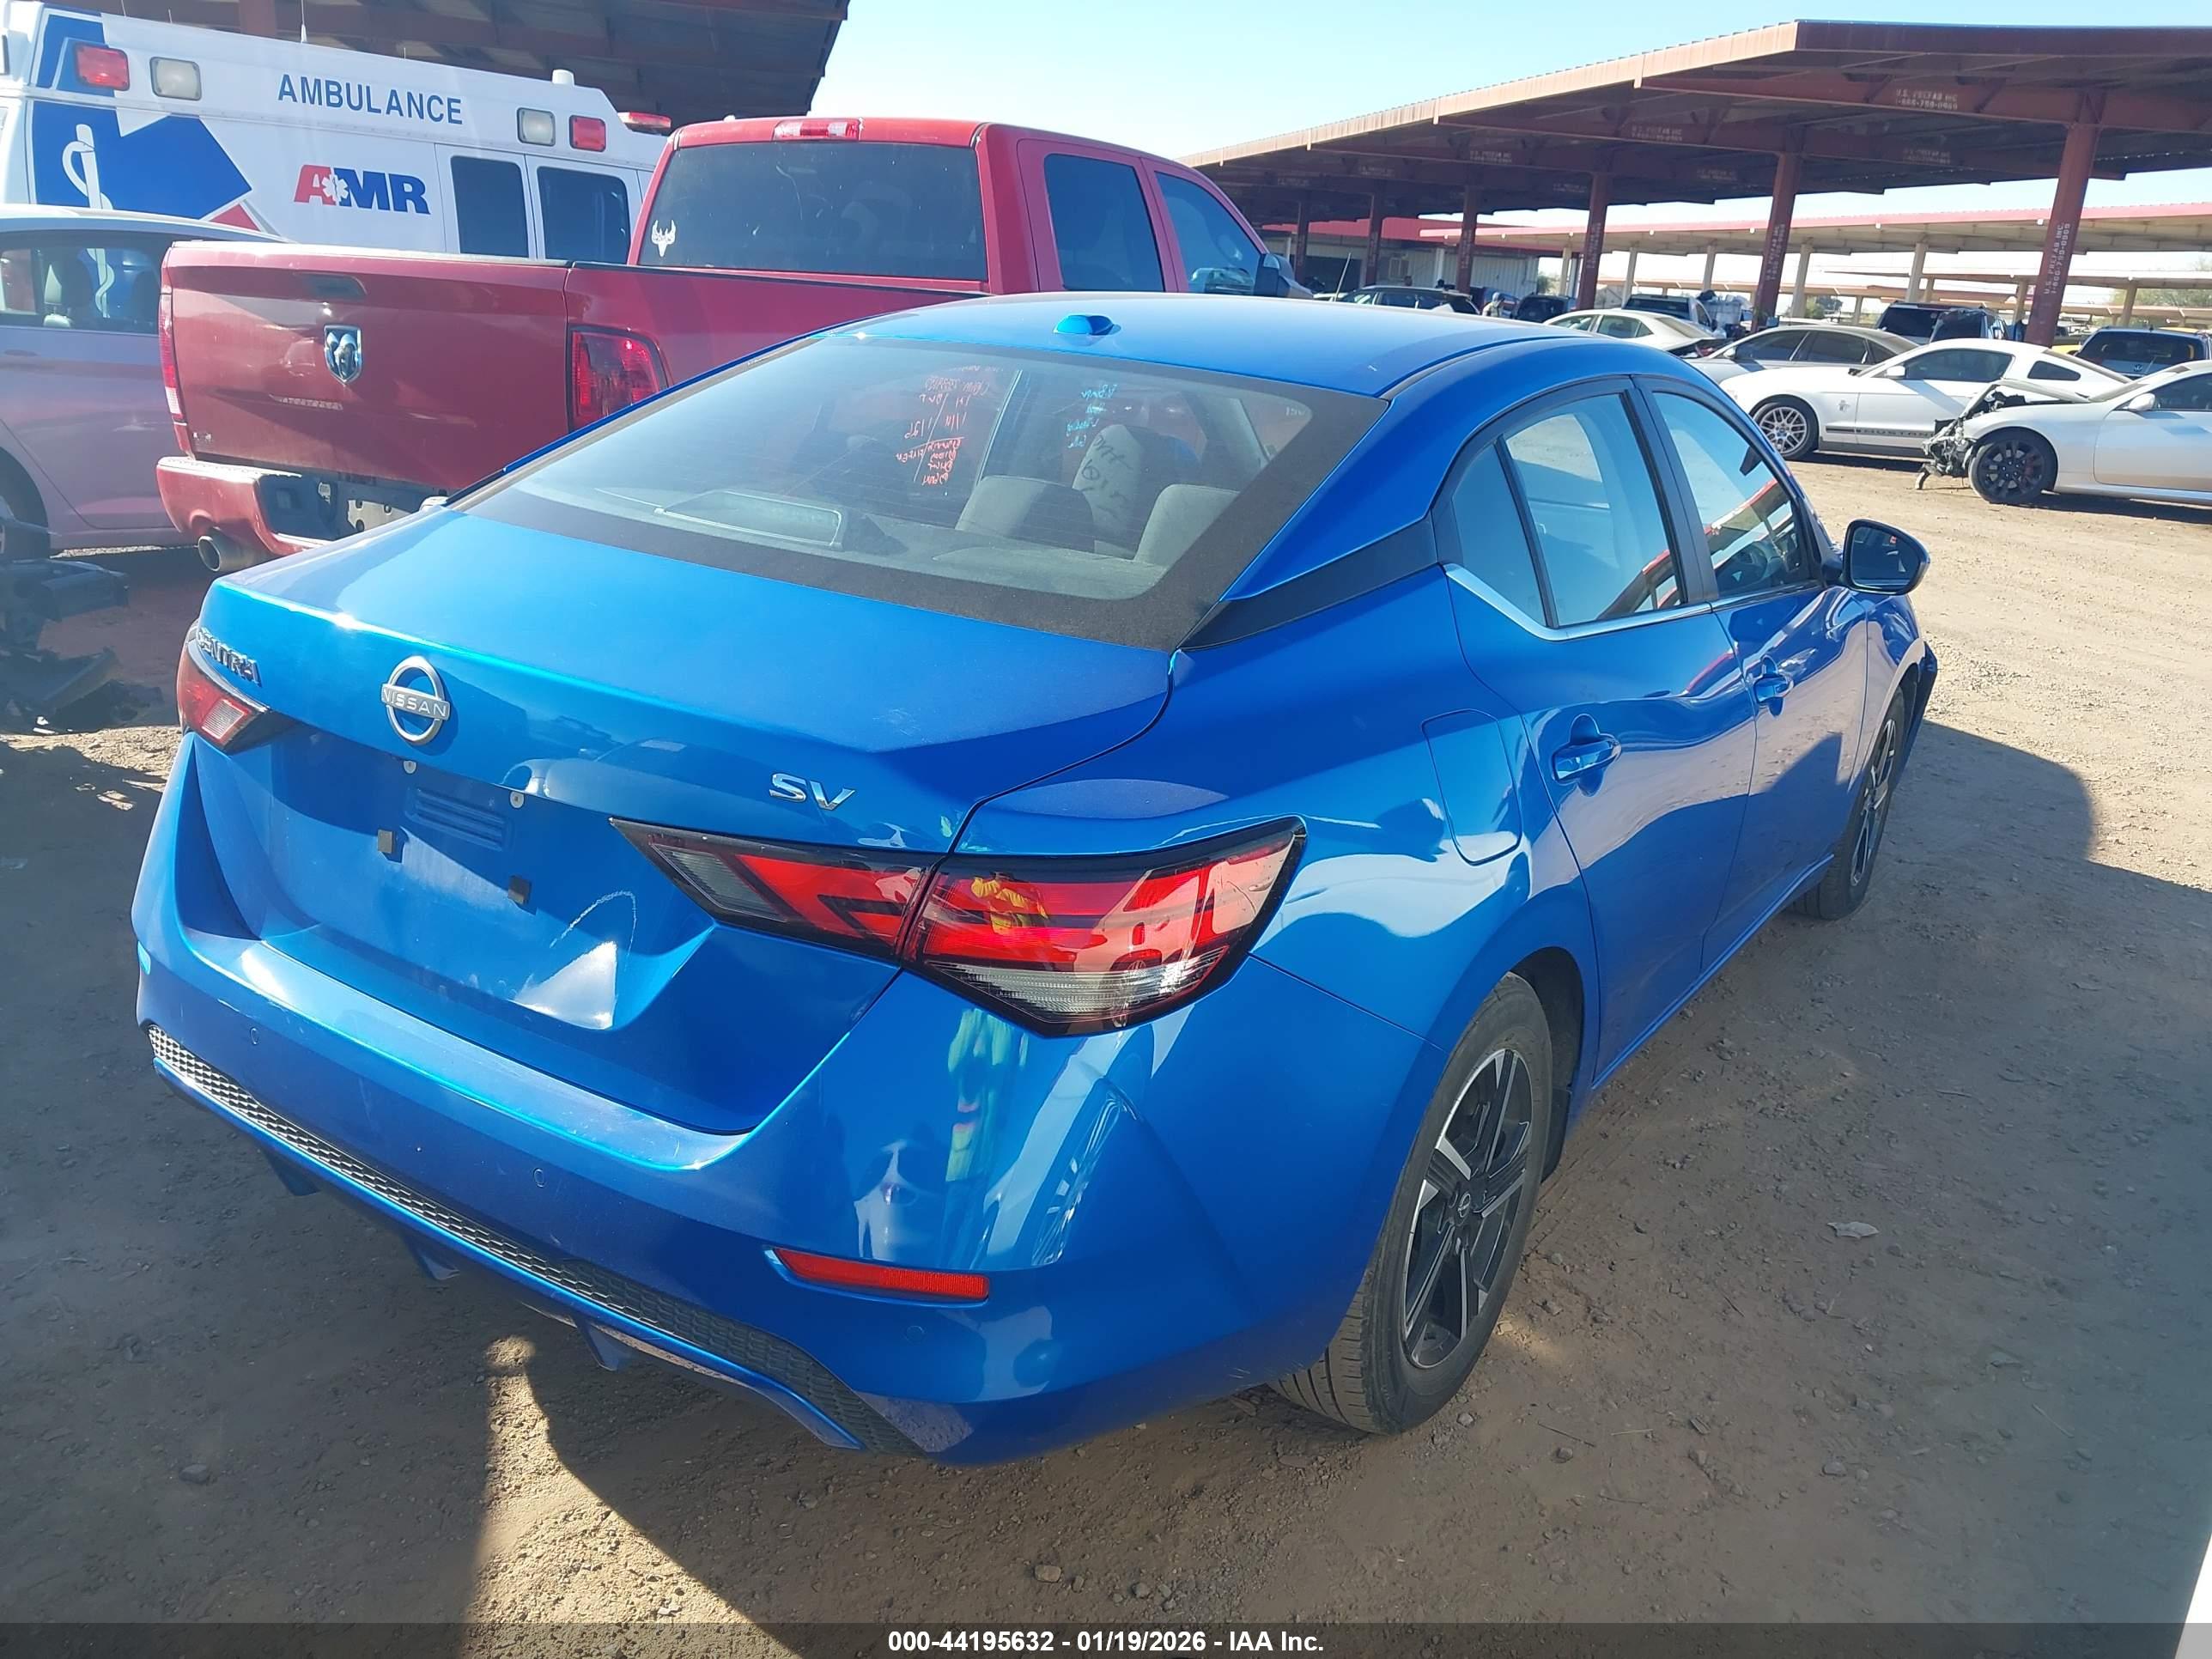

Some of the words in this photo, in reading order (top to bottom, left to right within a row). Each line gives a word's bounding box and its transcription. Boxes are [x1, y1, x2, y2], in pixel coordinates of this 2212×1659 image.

[277, 73, 464, 125] AMBULANCE
[294, 164, 431, 215] AMR
[382, 688, 447, 718] NISSAN
[769, 772, 856, 811] SV
